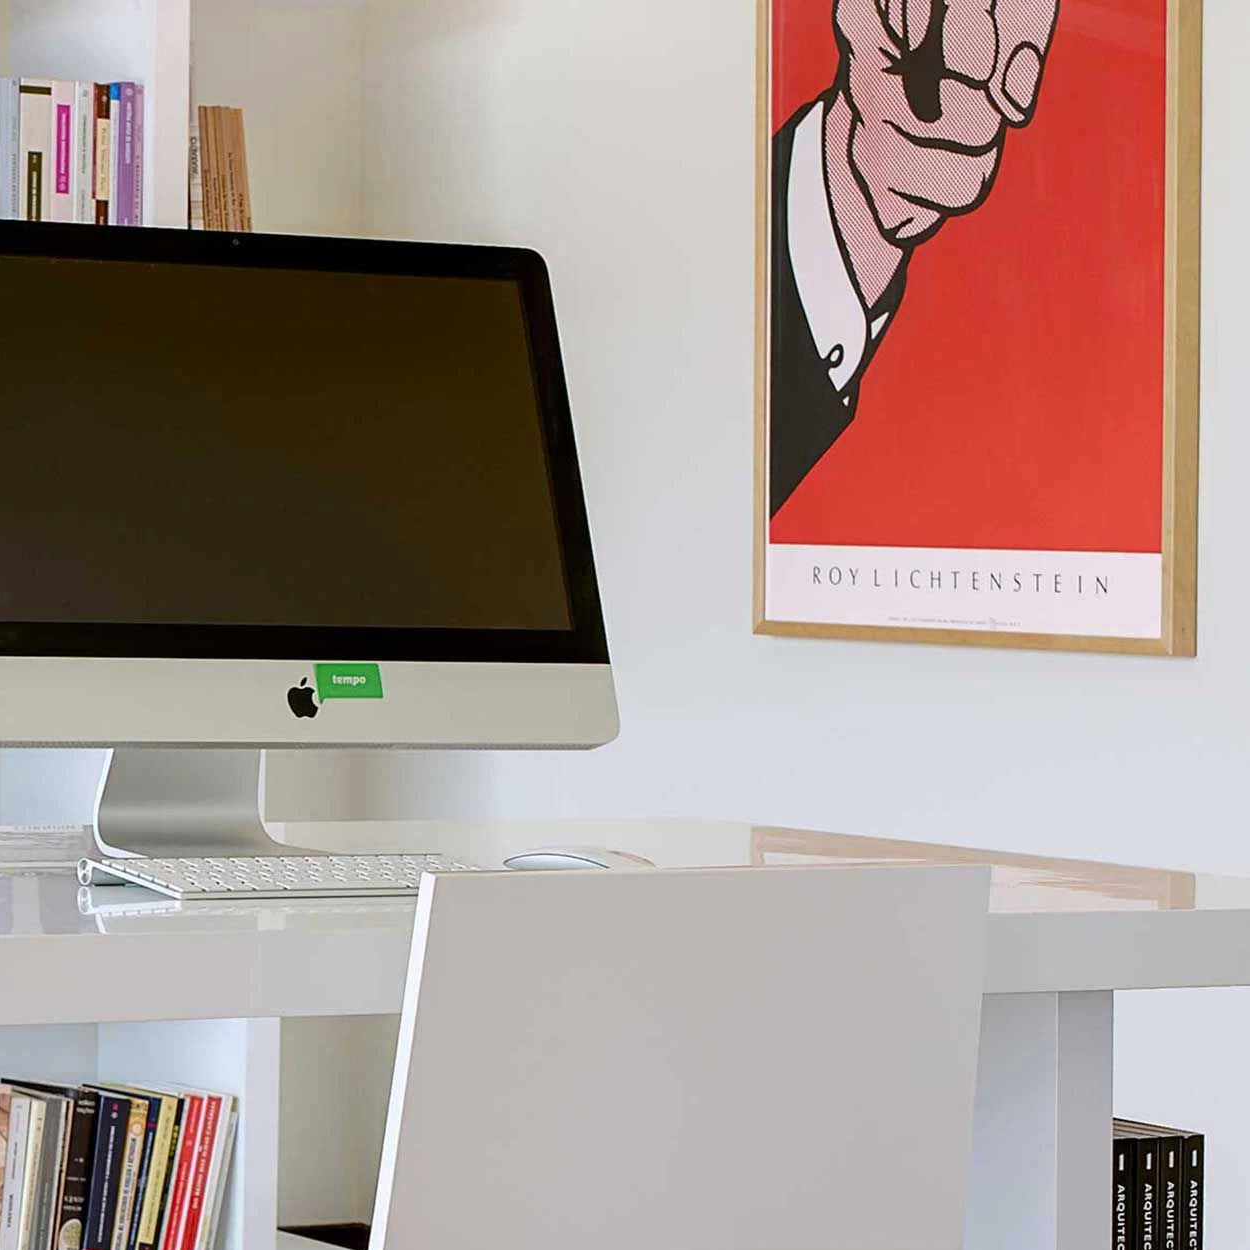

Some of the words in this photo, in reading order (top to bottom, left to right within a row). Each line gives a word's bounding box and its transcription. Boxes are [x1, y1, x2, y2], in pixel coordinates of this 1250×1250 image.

[813, 566, 859, 587] ROY
[873, 569, 1109, 595] LICHTENSTEIN
[332, 675, 366, 686] tempo
